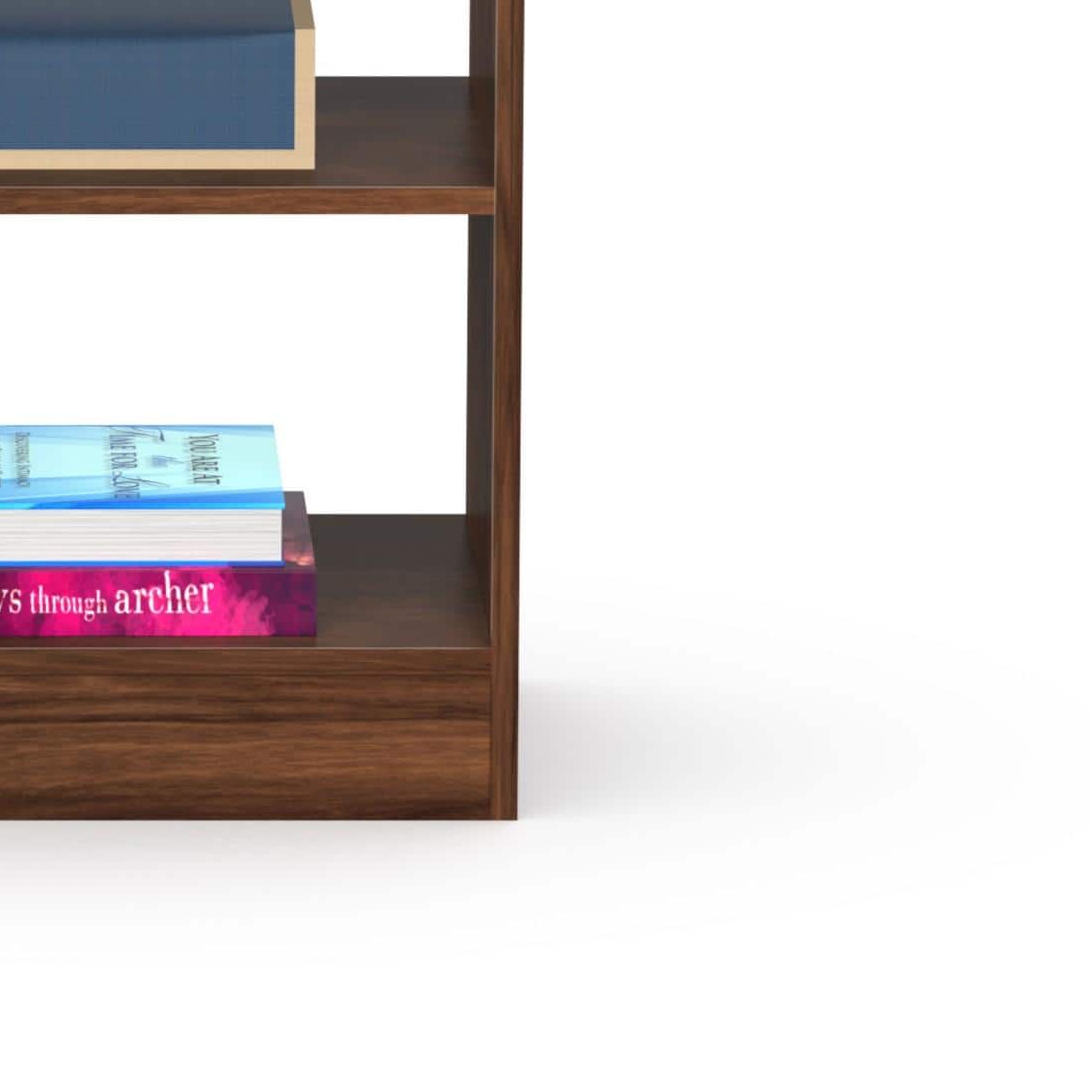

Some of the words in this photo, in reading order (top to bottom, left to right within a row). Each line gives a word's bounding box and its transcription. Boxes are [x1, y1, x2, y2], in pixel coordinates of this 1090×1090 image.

[188, 434, 219, 453] YOU
[110, 451, 138, 470] FOR
[190, 454, 220, 471] ARE
[193, 472, 222, 485] AT
[29, 585, 108, 622] through
[114, 570, 215, 615] archer
